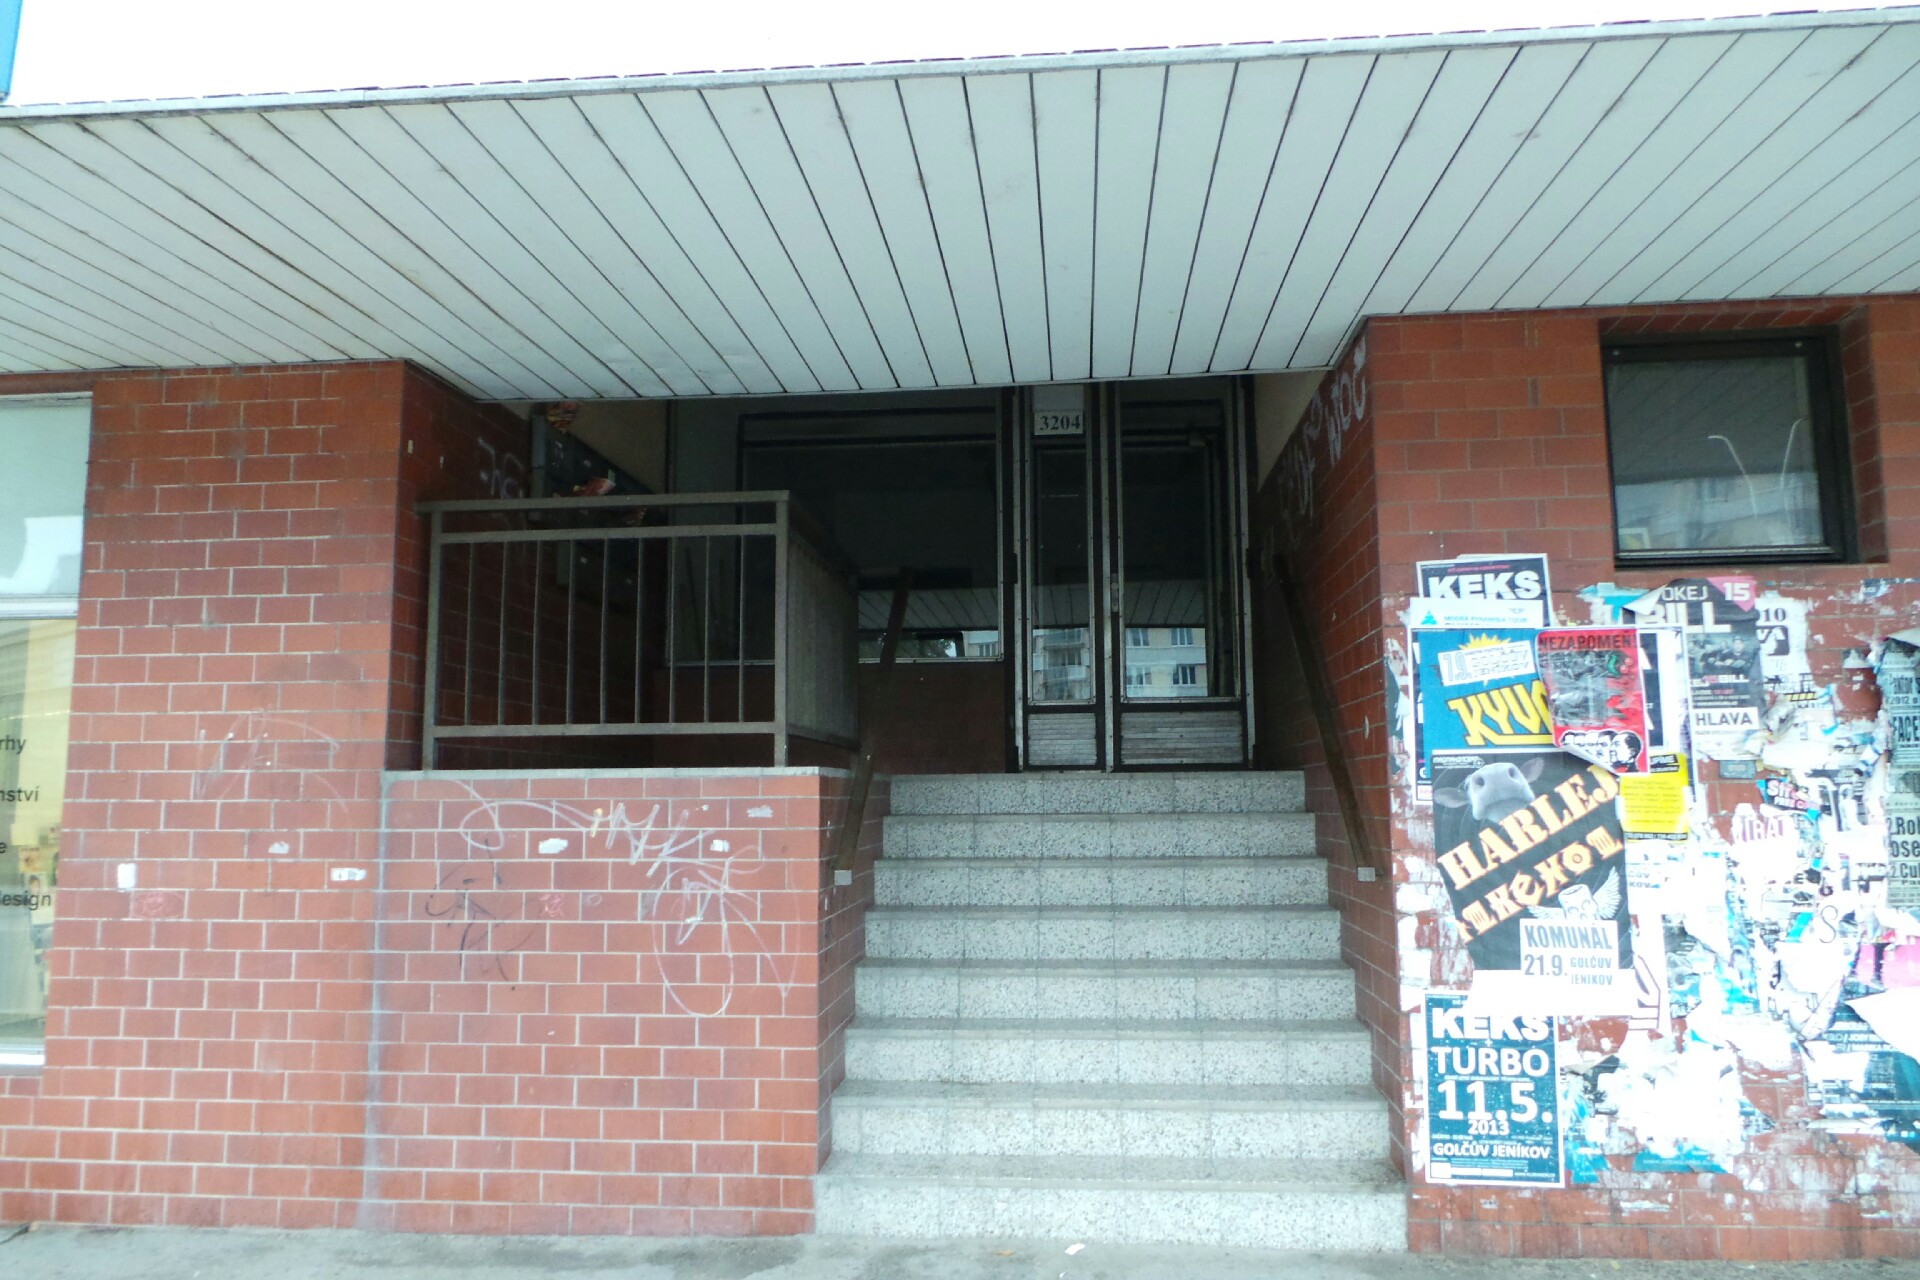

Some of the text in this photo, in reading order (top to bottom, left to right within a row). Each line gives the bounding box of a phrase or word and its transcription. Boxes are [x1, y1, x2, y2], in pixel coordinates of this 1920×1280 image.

[1039, 414, 1081, 431] 3204
[1427, 570, 1542, 600] KEKS
[1723, 582, 1750, 601] 15
[1695, 711, 1753, 726] HLAVA
[1437, 763, 1621, 891] HARLEJ
[0, 890, 52, 911] esign
[1523, 954, 1567, 977] 21.9.
[1431, 1007, 1551, 1041] KEKS
[1430, 1046, 1550, 1077] TURBO
[1436, 1079, 1554, 1123] 11.5.
[1467, 1119, 1510, 1136] 2013
[1433, 1140, 1489, 1157] GOLČŮV
[1490, 1143, 1550, 1159] JENÍKOV
